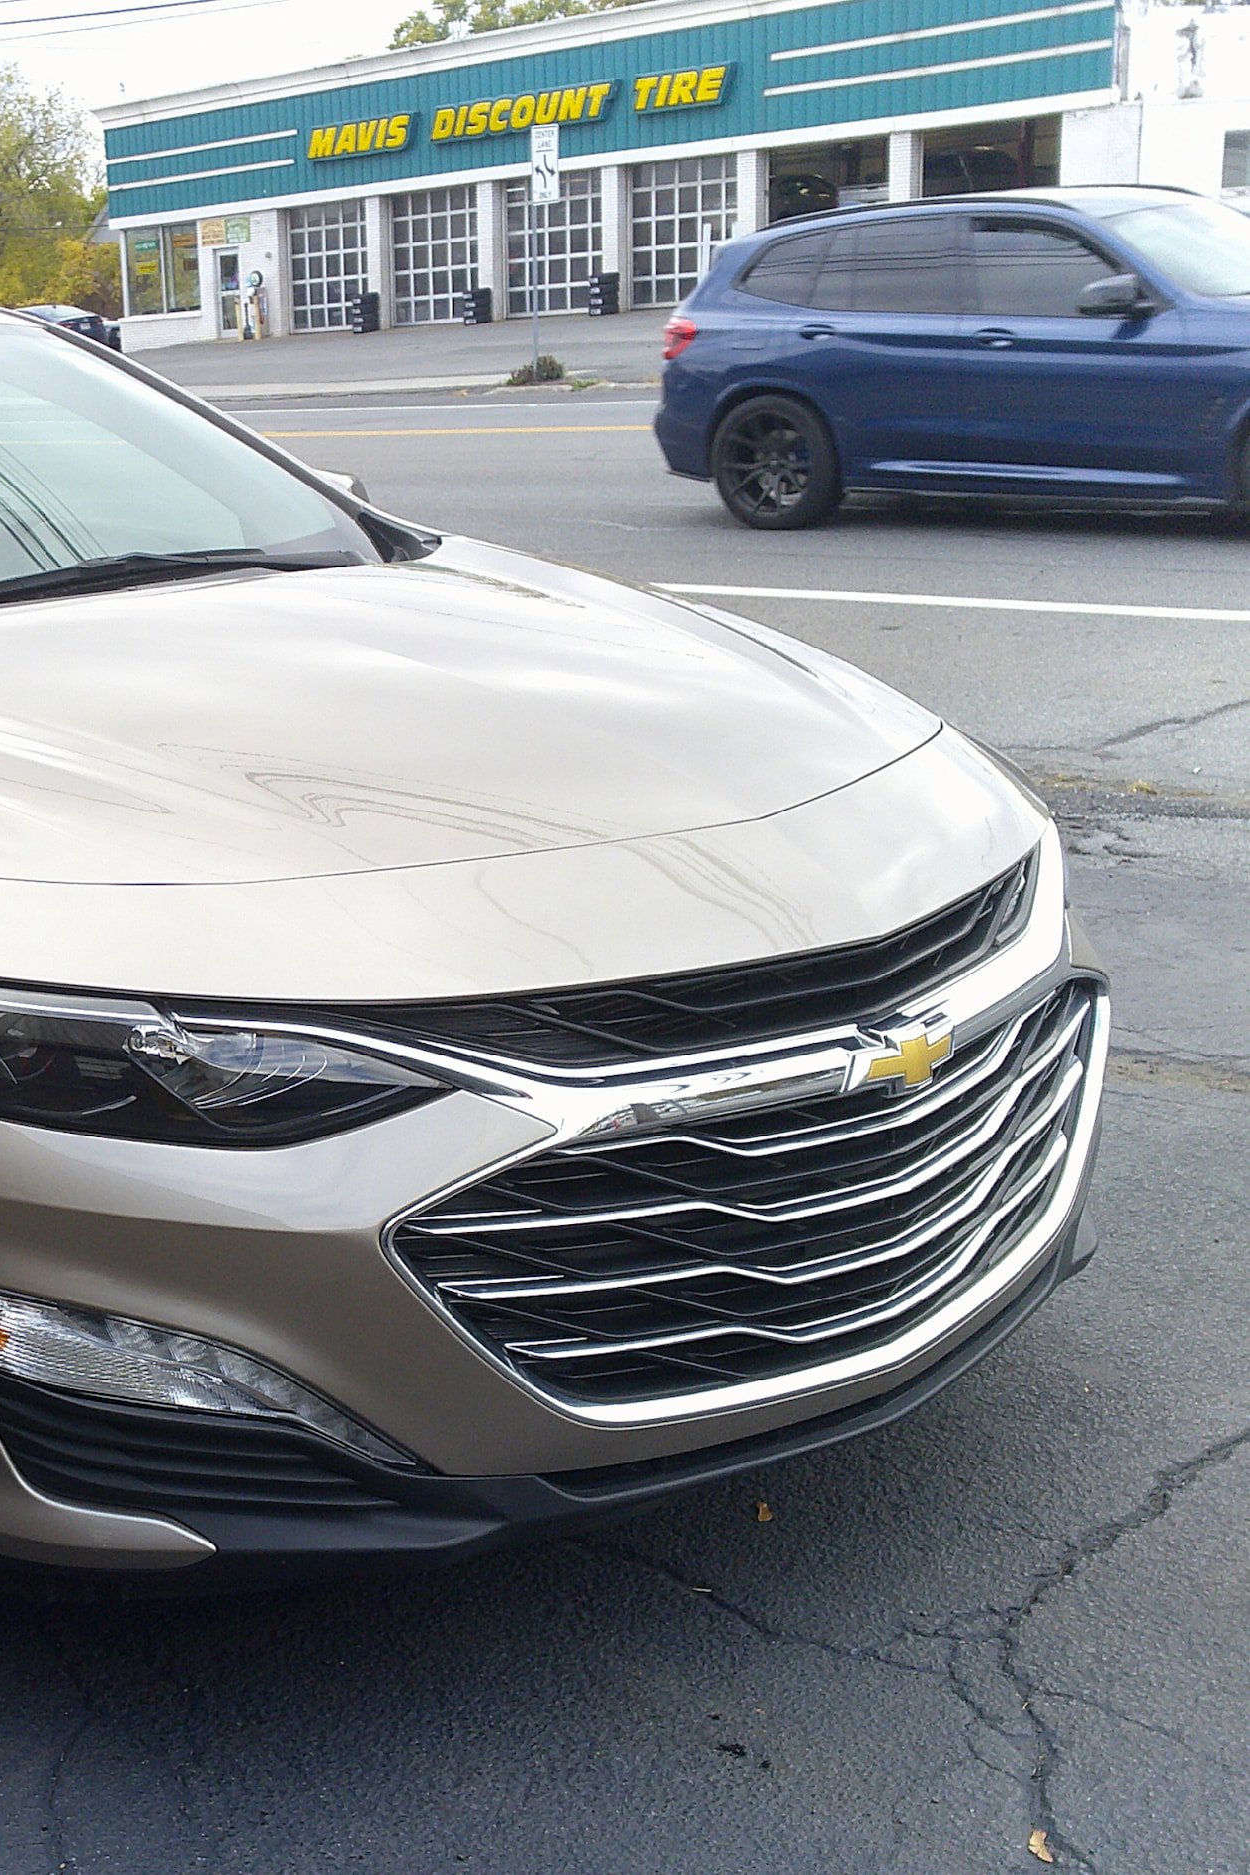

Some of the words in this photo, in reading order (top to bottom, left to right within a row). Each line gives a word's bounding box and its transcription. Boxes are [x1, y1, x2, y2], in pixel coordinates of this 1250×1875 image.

[307, 114, 410, 160] MAVIS
[431, 82, 612, 140] DISCOUNT
[634, 66, 727, 111] TIRE
[534, 129, 555, 139] CENTER
[537, 140, 552, 149] LANE
